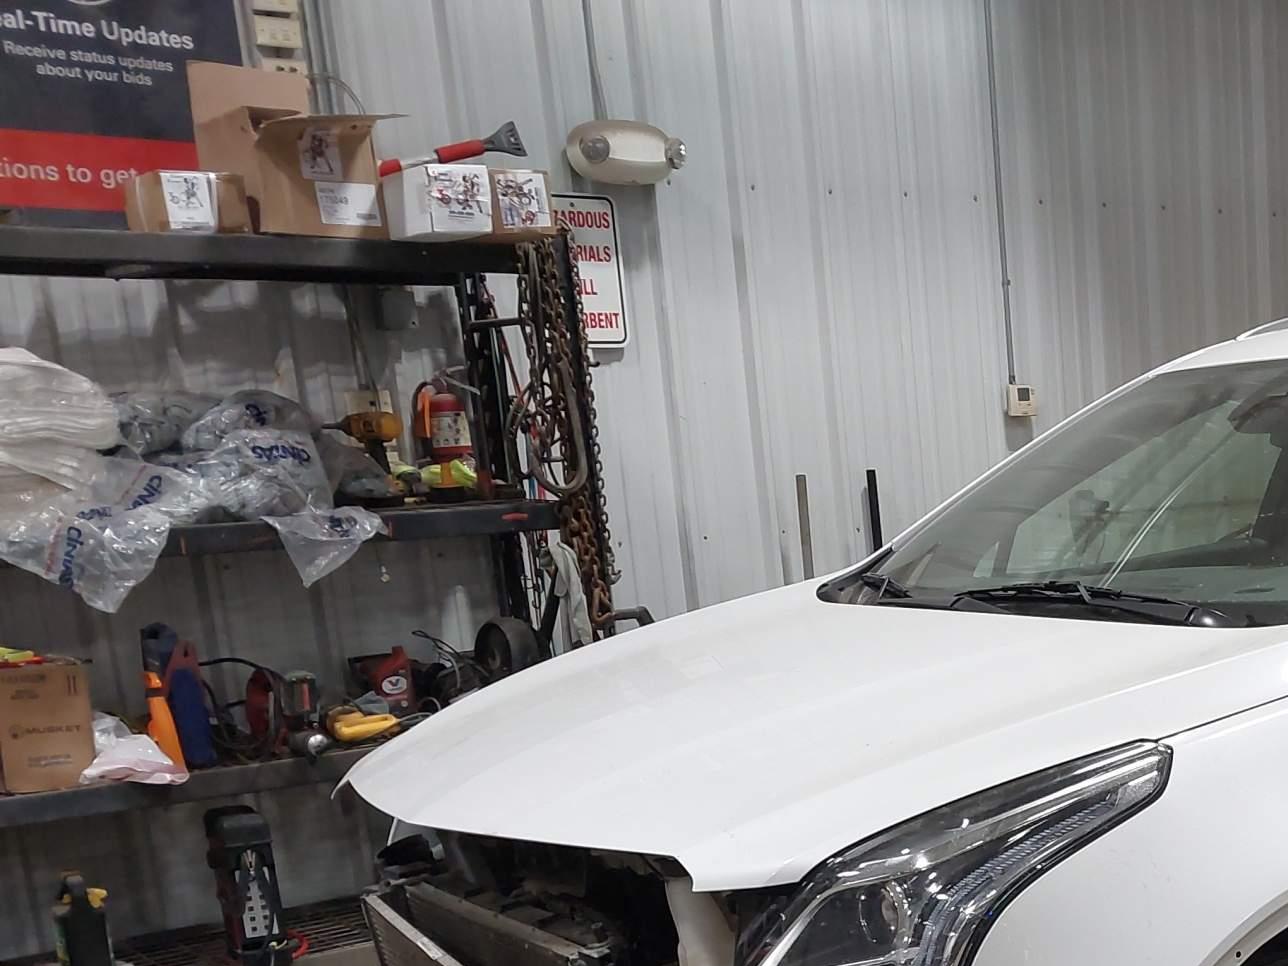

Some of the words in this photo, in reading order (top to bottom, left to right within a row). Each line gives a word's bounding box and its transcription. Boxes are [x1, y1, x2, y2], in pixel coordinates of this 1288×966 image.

[0, 9, 96, 37] al-Time
[101, 20, 194, 49] Updates
[3, 40, 67, 60] Receive
[70, 48, 115, 65] status
[118, 55, 174, 72] updates
[36, 63, 82, 78] about
[85, 68, 119, 82] your
[123, 71, 153, 86] bids
[66, 163, 92, 183] to
[100, 167, 137, 189] get
